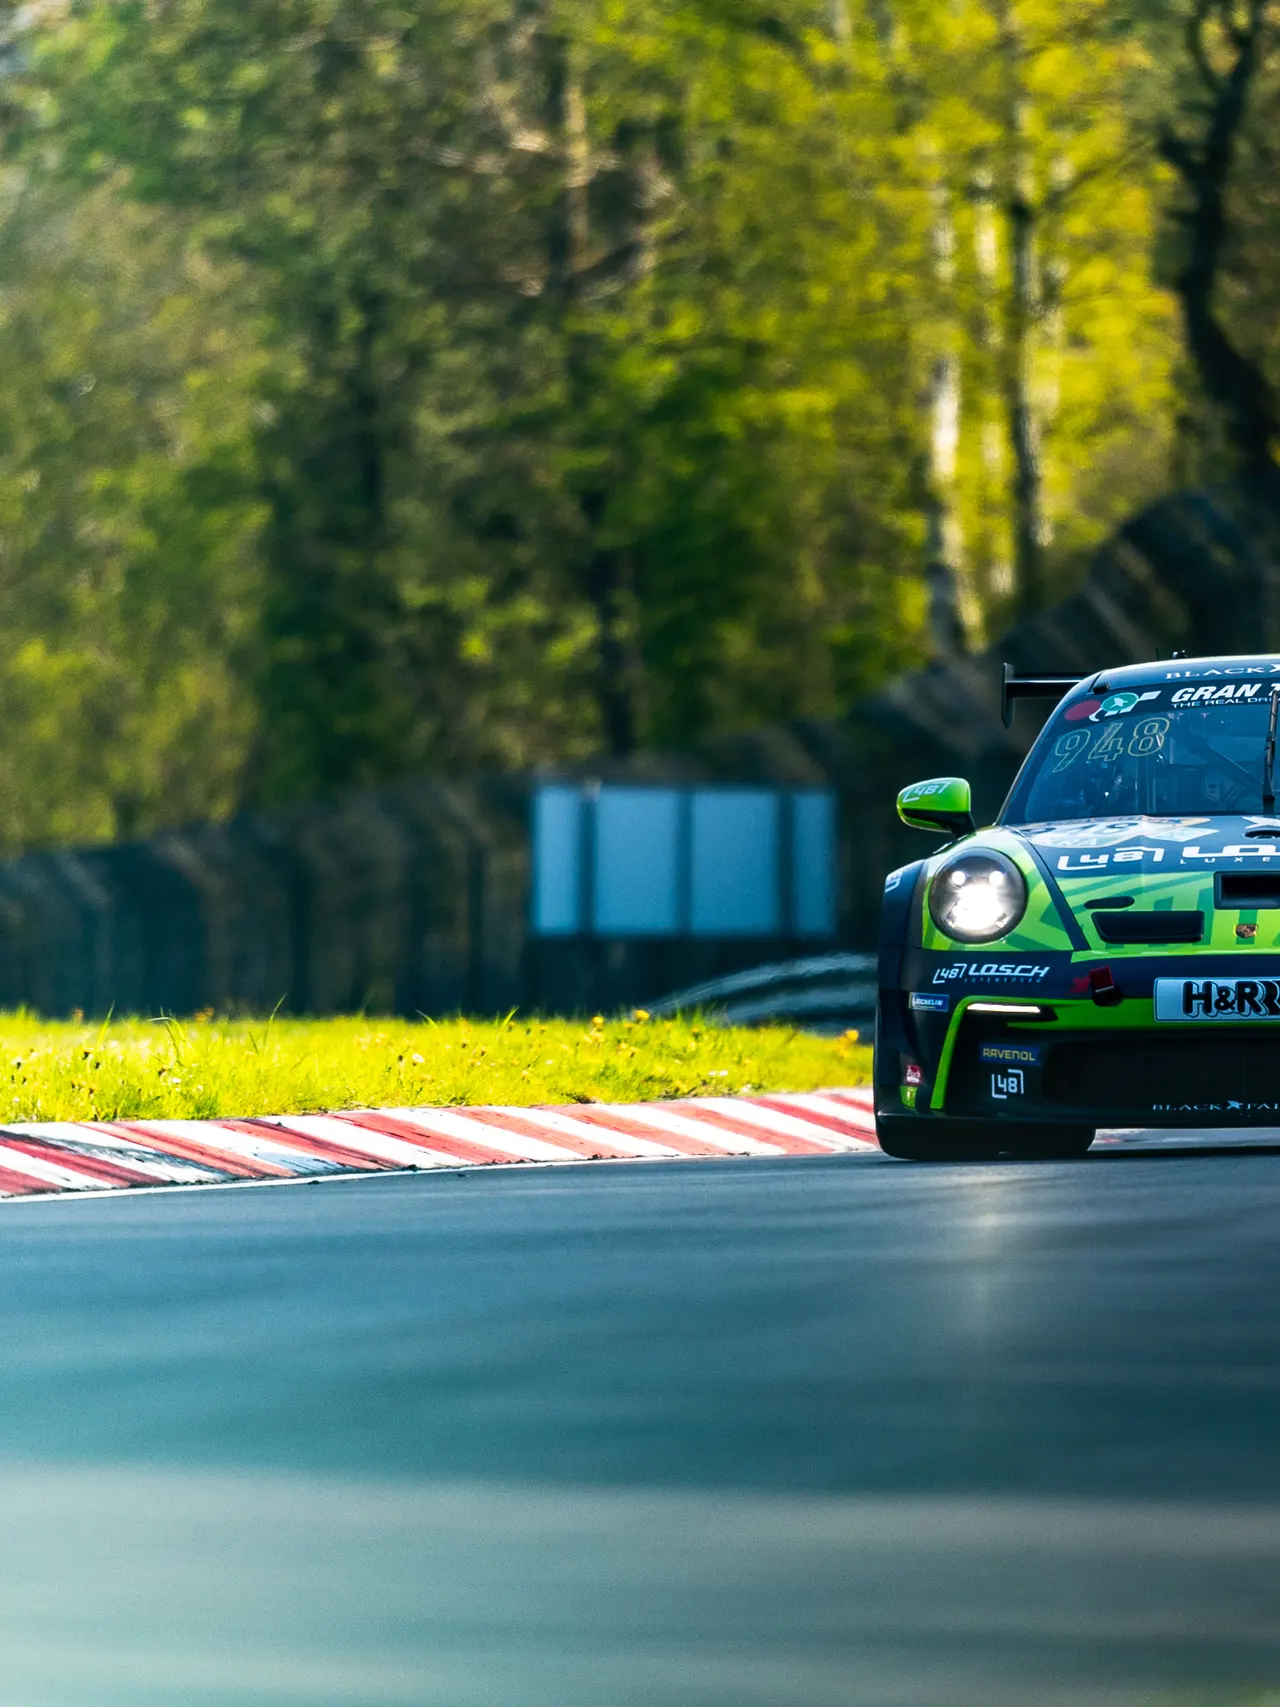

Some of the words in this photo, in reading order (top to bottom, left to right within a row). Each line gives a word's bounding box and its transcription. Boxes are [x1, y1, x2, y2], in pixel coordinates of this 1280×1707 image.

[1165, 667, 1265, 679] BLACK
[1171, 682, 1262, 703] GRAN
[1171, 701, 1200, 709] THE
[1205, 698, 1244, 706] REAL
[1052, 717, 1170, 773] 948
[968, 963, 1050, 977] LOSCH
[983, 1048, 1036, 1061] RAVENOL
